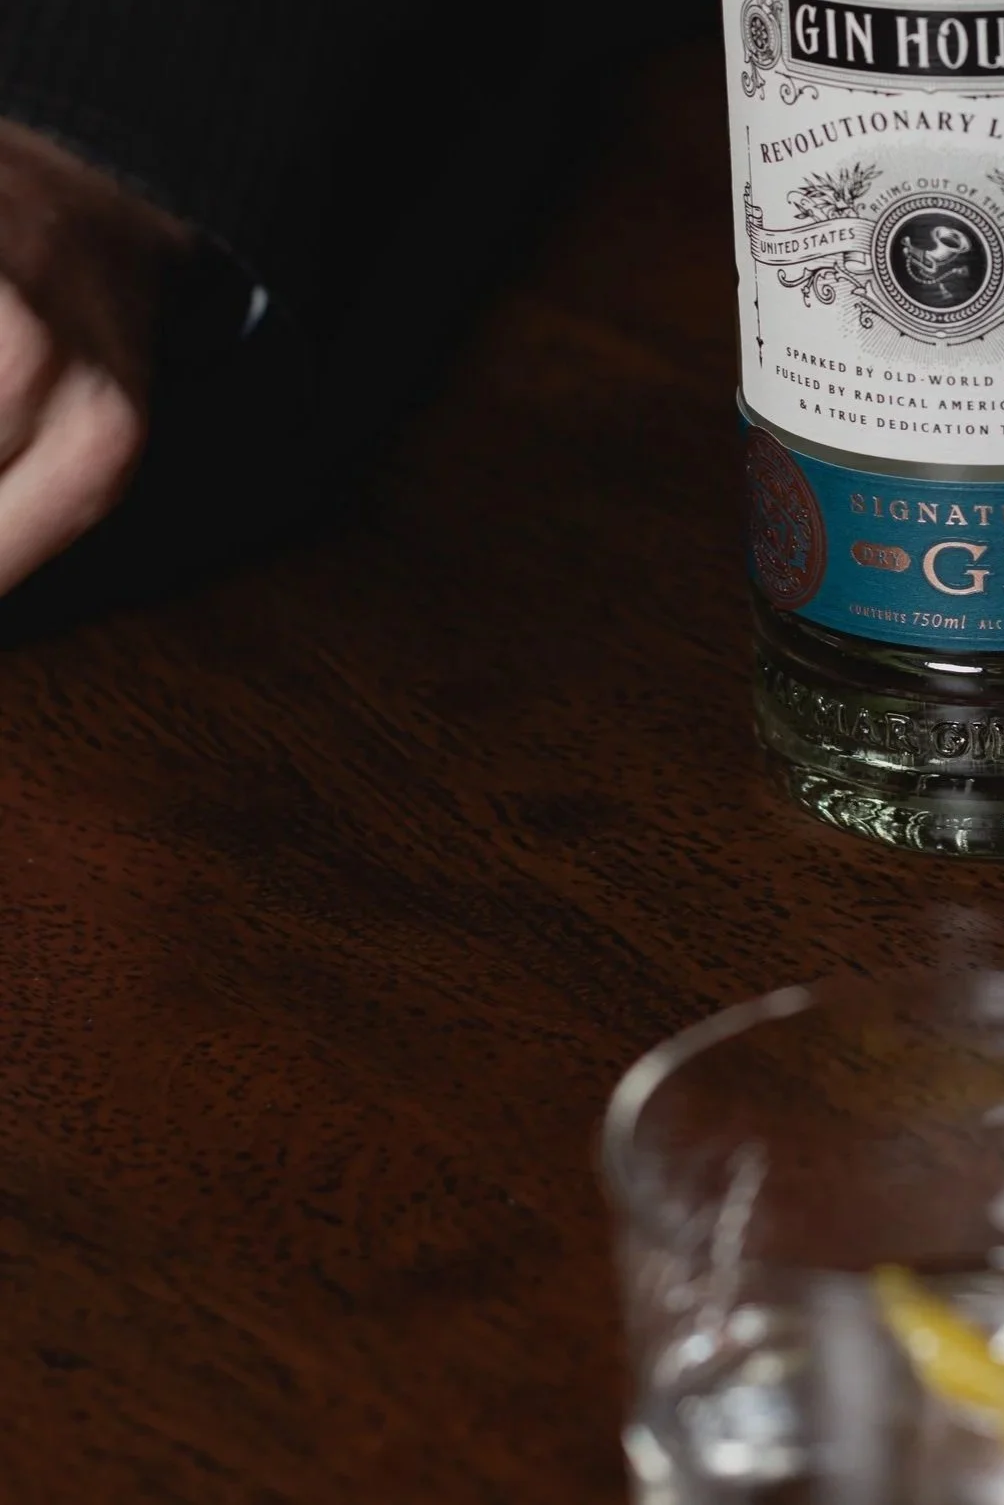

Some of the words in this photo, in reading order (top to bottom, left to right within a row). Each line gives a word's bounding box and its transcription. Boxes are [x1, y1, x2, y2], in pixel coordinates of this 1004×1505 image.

[795, 2, 874, 62] GIN
[760, 109, 976, 164] REVOLUTIONARY
[870, 180, 911, 214] RISING
[917, 177, 951, 189] OUT
[956, 183, 979, 197] OF
[760, 240, 800, 255] UNITED
[803, 227, 856, 251] STATES
[786, 346, 846, 373] SPARKED
[856, 366, 874, 378] BY
[884, 370, 994, 387] OLD-WORLD
[776, 365, 820, 390] FUELED
[829, 384, 845, 397] BY
[854, 389, 928, 409] RADICAL
[800, 398, 808, 410] &
[814, 404, 821, 415] A
[829, 408, 867, 425] TRUE
[877, 417, 989, 436] DEDICATION
[863, 546, 902, 568] DRY
[912, 612, 966, 630] 750ml
